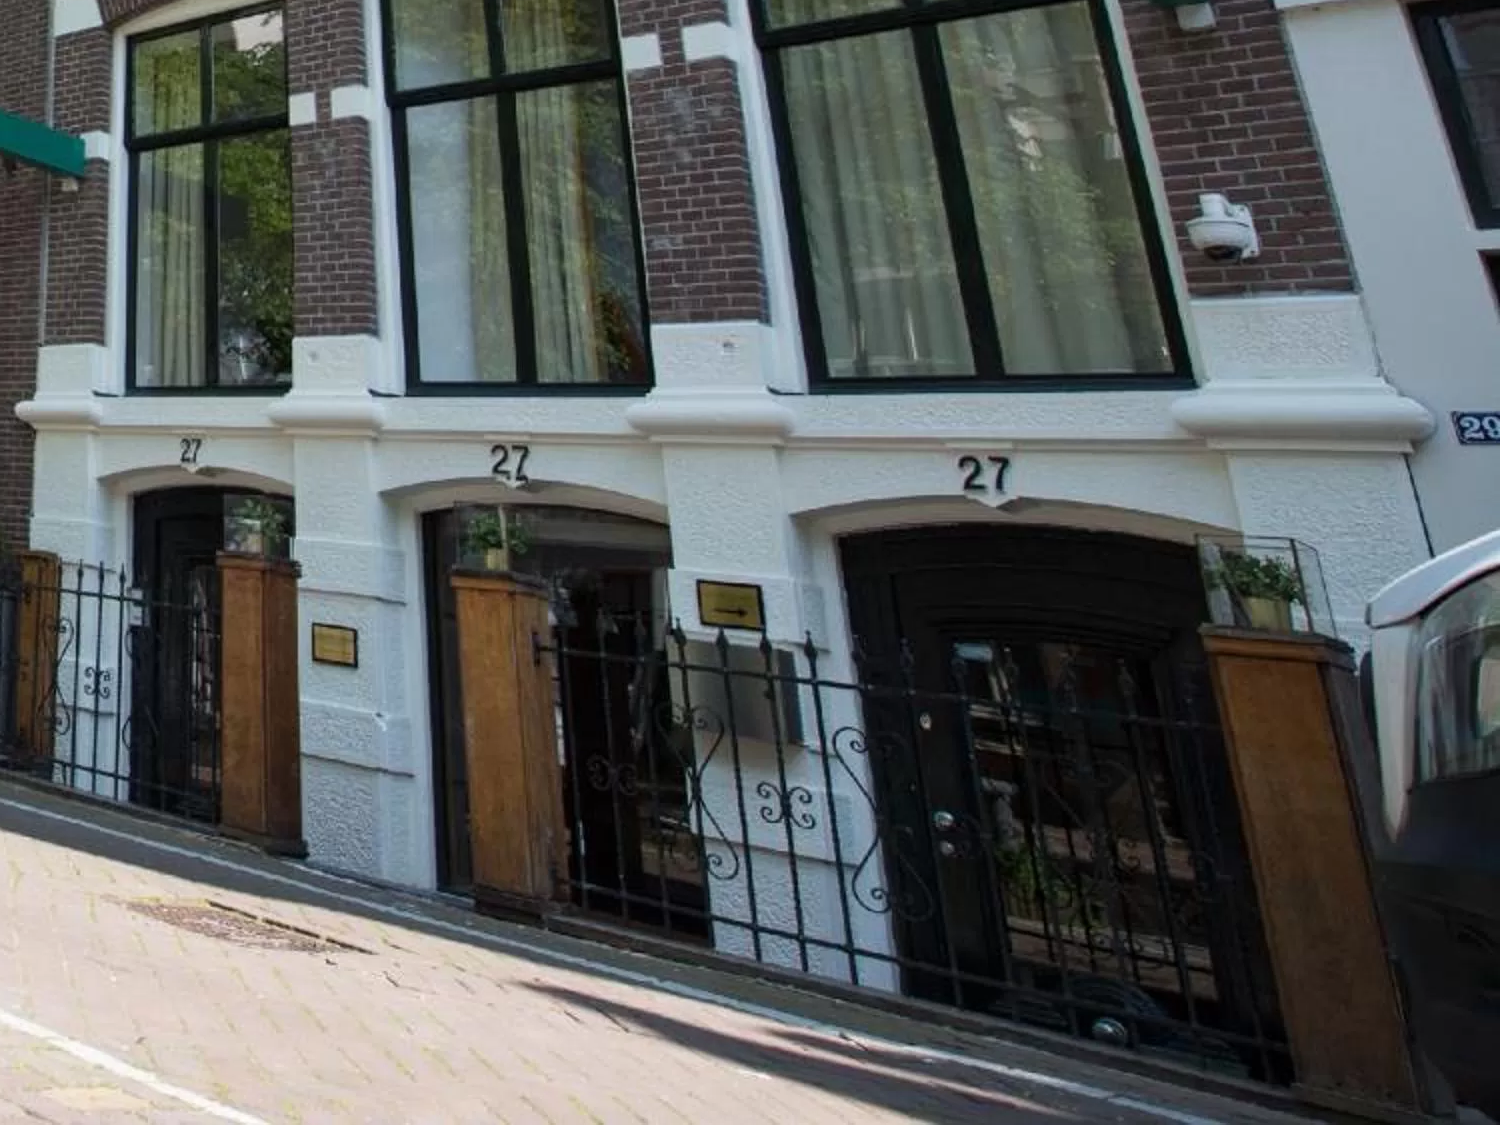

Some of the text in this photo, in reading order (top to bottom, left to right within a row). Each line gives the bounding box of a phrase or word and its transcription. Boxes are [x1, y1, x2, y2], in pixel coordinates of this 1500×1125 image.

[180, 438, 202, 463] 27
[491, 444, 530, 479] 27
[959, 455, 1009, 491] 27
